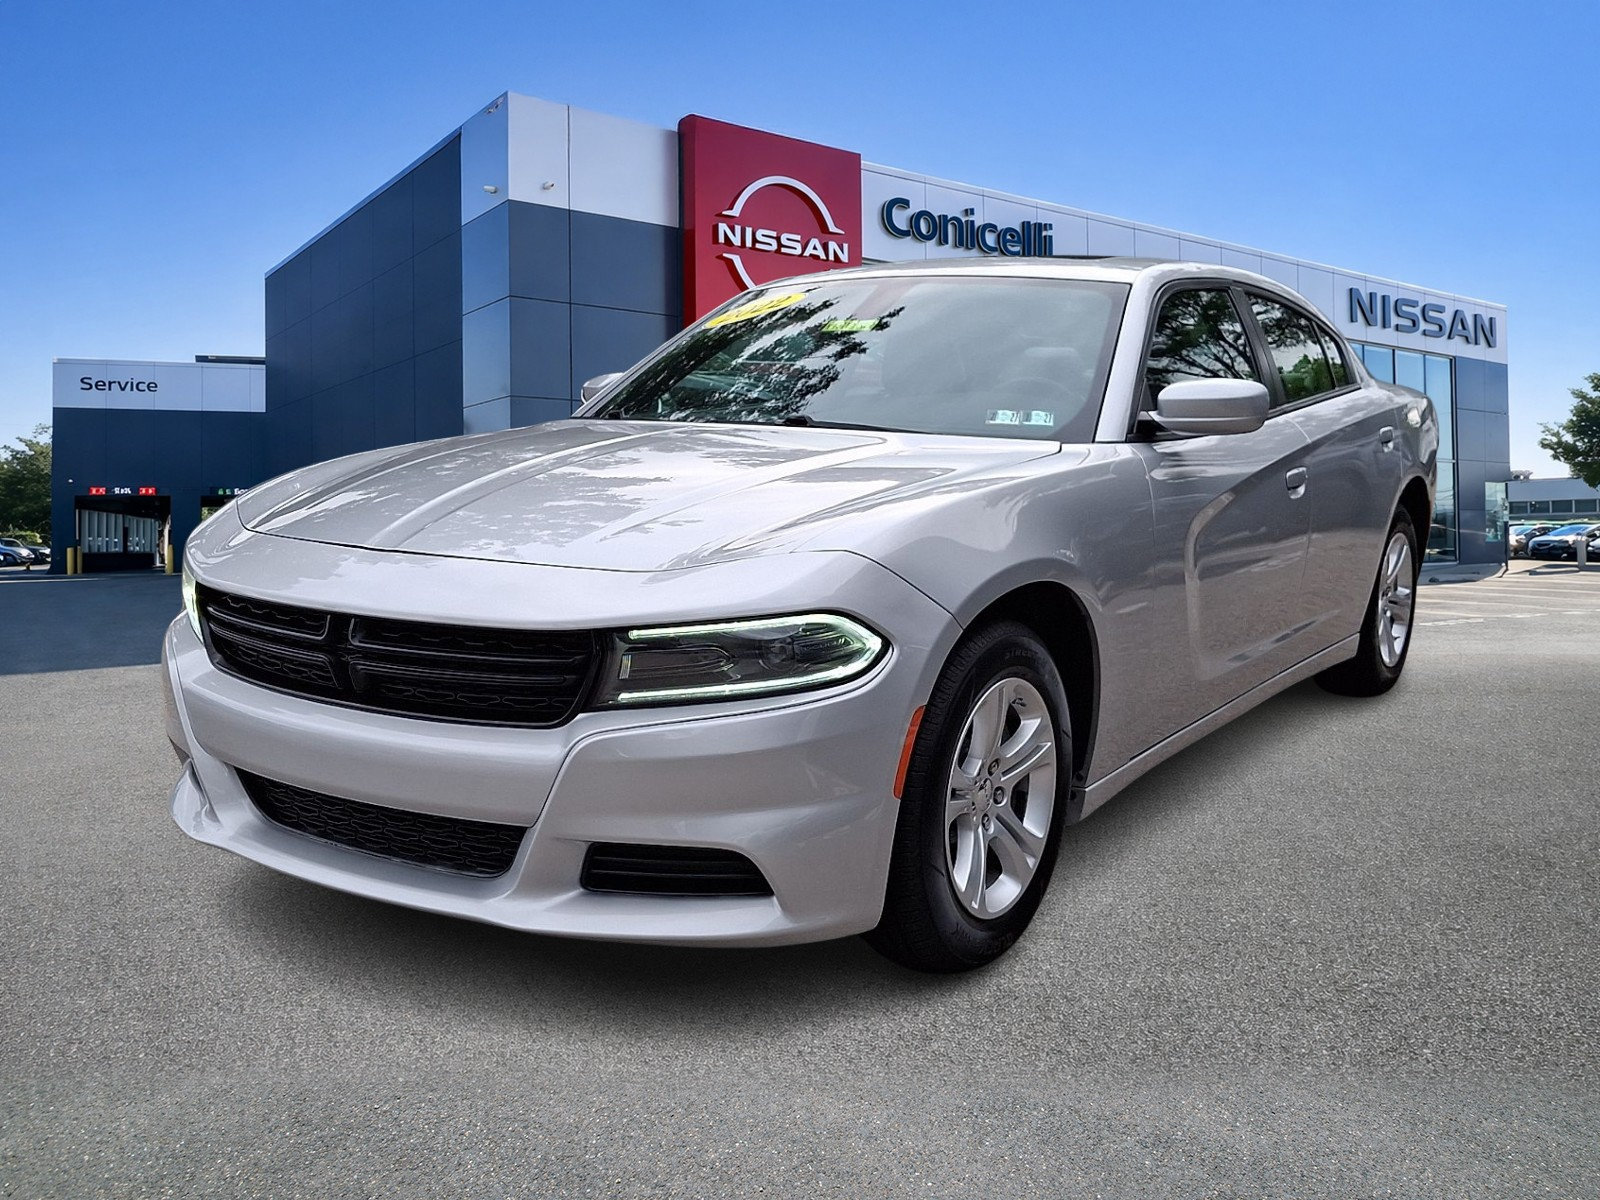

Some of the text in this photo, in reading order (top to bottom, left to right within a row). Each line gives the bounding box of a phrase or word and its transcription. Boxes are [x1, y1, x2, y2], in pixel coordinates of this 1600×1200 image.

[717, 222, 849, 263] NISSAN
[881, 197, 1053, 257] Conicelli
[1348, 287, 1497, 348] NISSAN
[79, 376, 158, 393] Service
